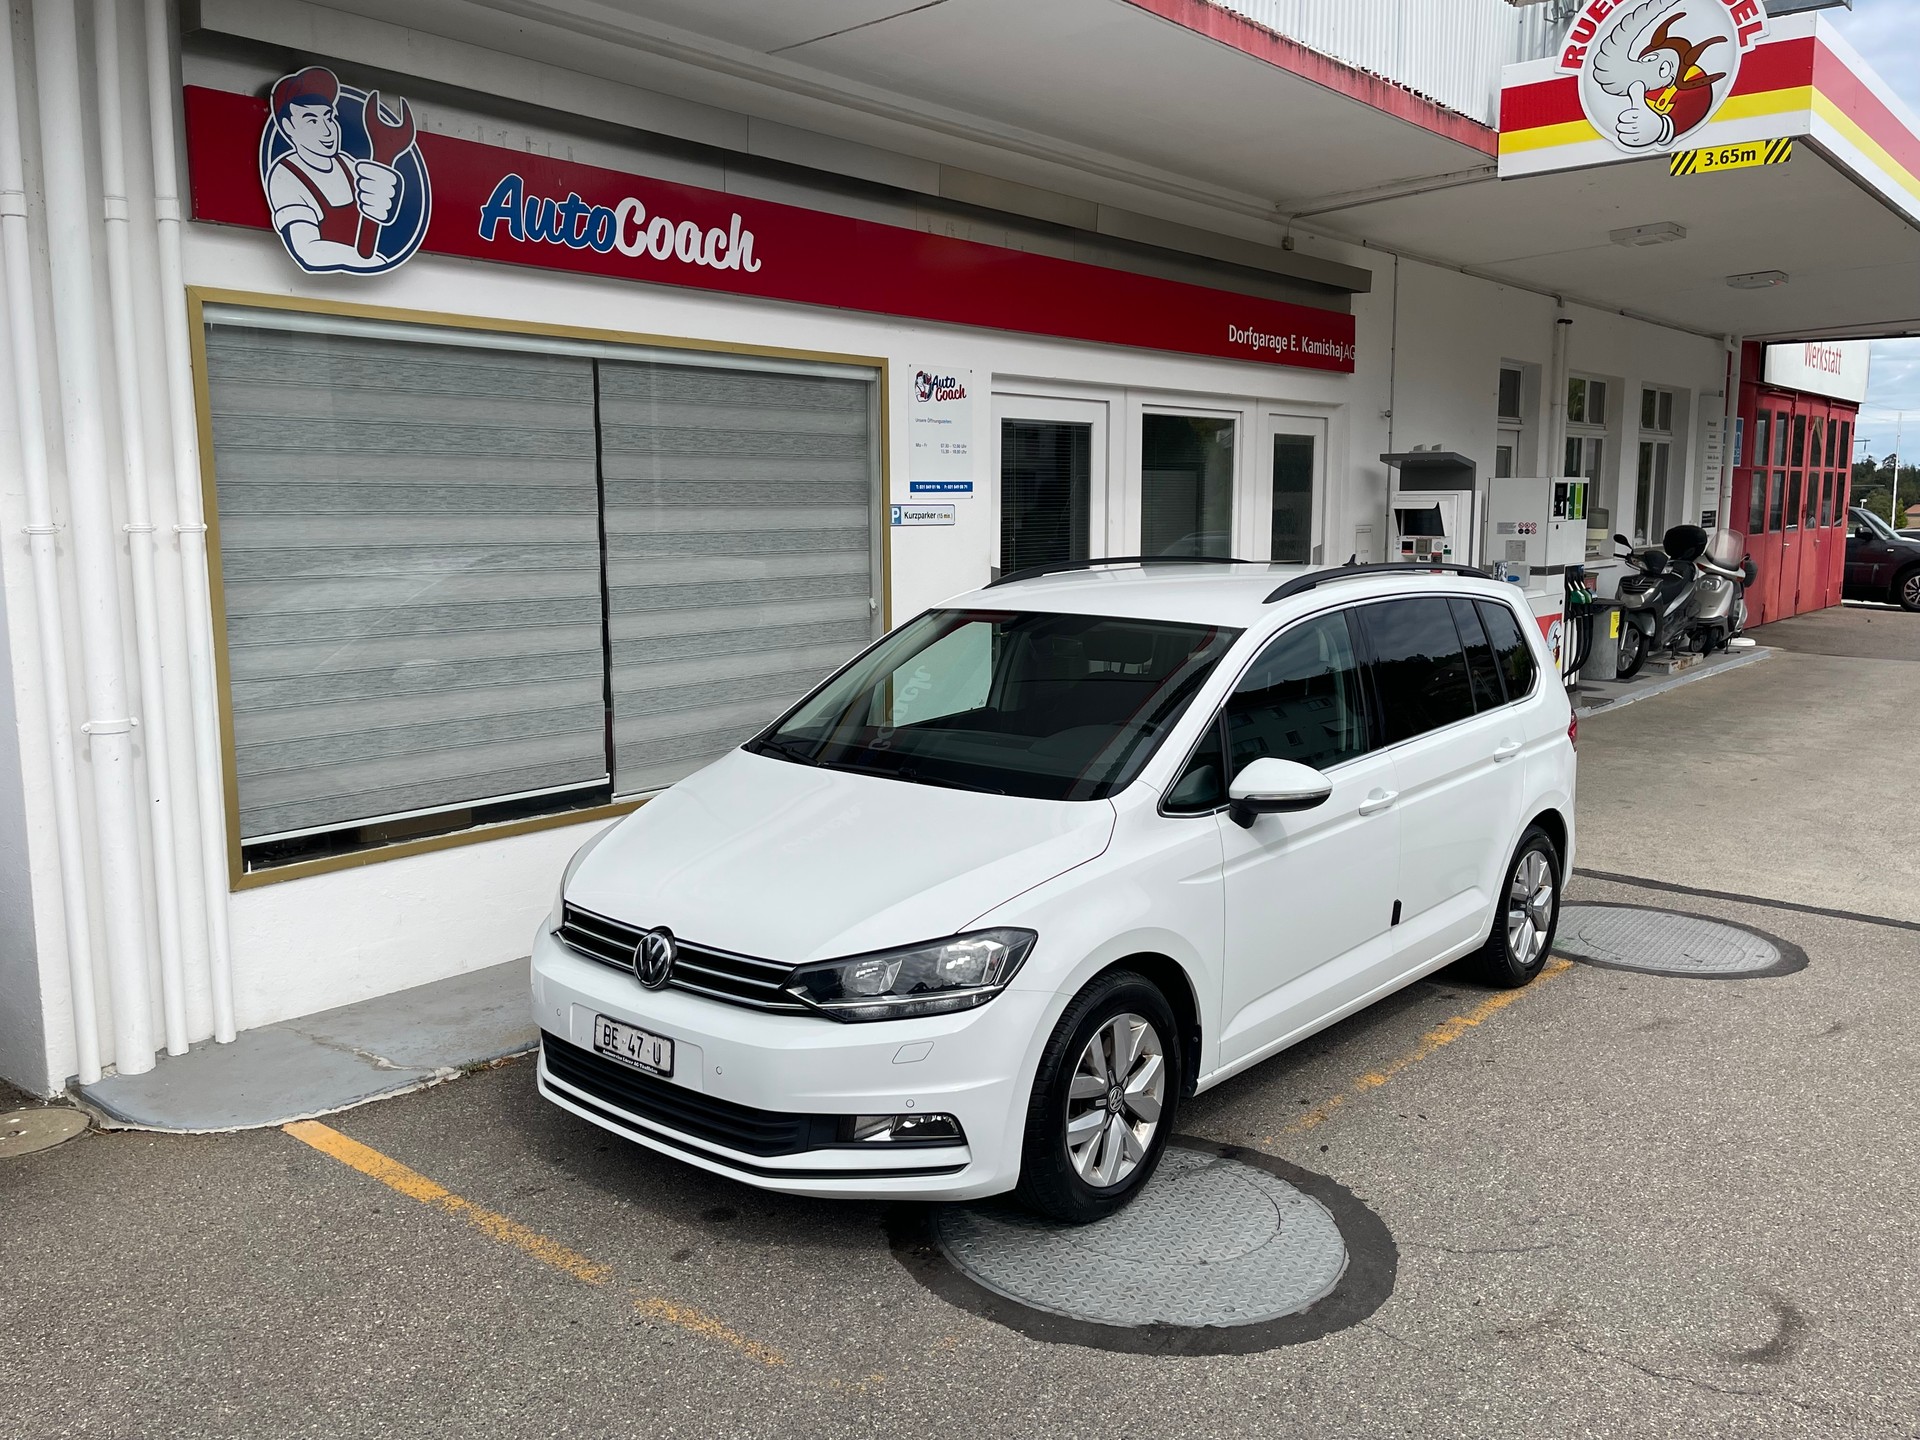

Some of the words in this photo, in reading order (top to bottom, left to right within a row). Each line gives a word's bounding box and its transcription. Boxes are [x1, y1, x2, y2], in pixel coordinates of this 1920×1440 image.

[1561, 0, 1624, 69] RUE
[1721, 0, 1763, 47] EL
[1704, 148, 1757, 167] 3.65m
[1228, 324, 1288, 354] Dorfgarage
[1290, 334, 1299, 352] E.
[1301, 336, 1343, 362] Kamishaj
[1343, 344, 1355, 360] AG
[1804, 341, 1842, 376] Werkstatt
[931, 374, 956, 391] Auto
[935, 383, 967, 402] Coach
[891, 507, 900, 524] P
[904, 511, 936, 521] Kurzparker
[603, 1023, 619, 1050] BE
[627, 1033, 644, 1059] 47
[653, 1041, 662, 1066] U
